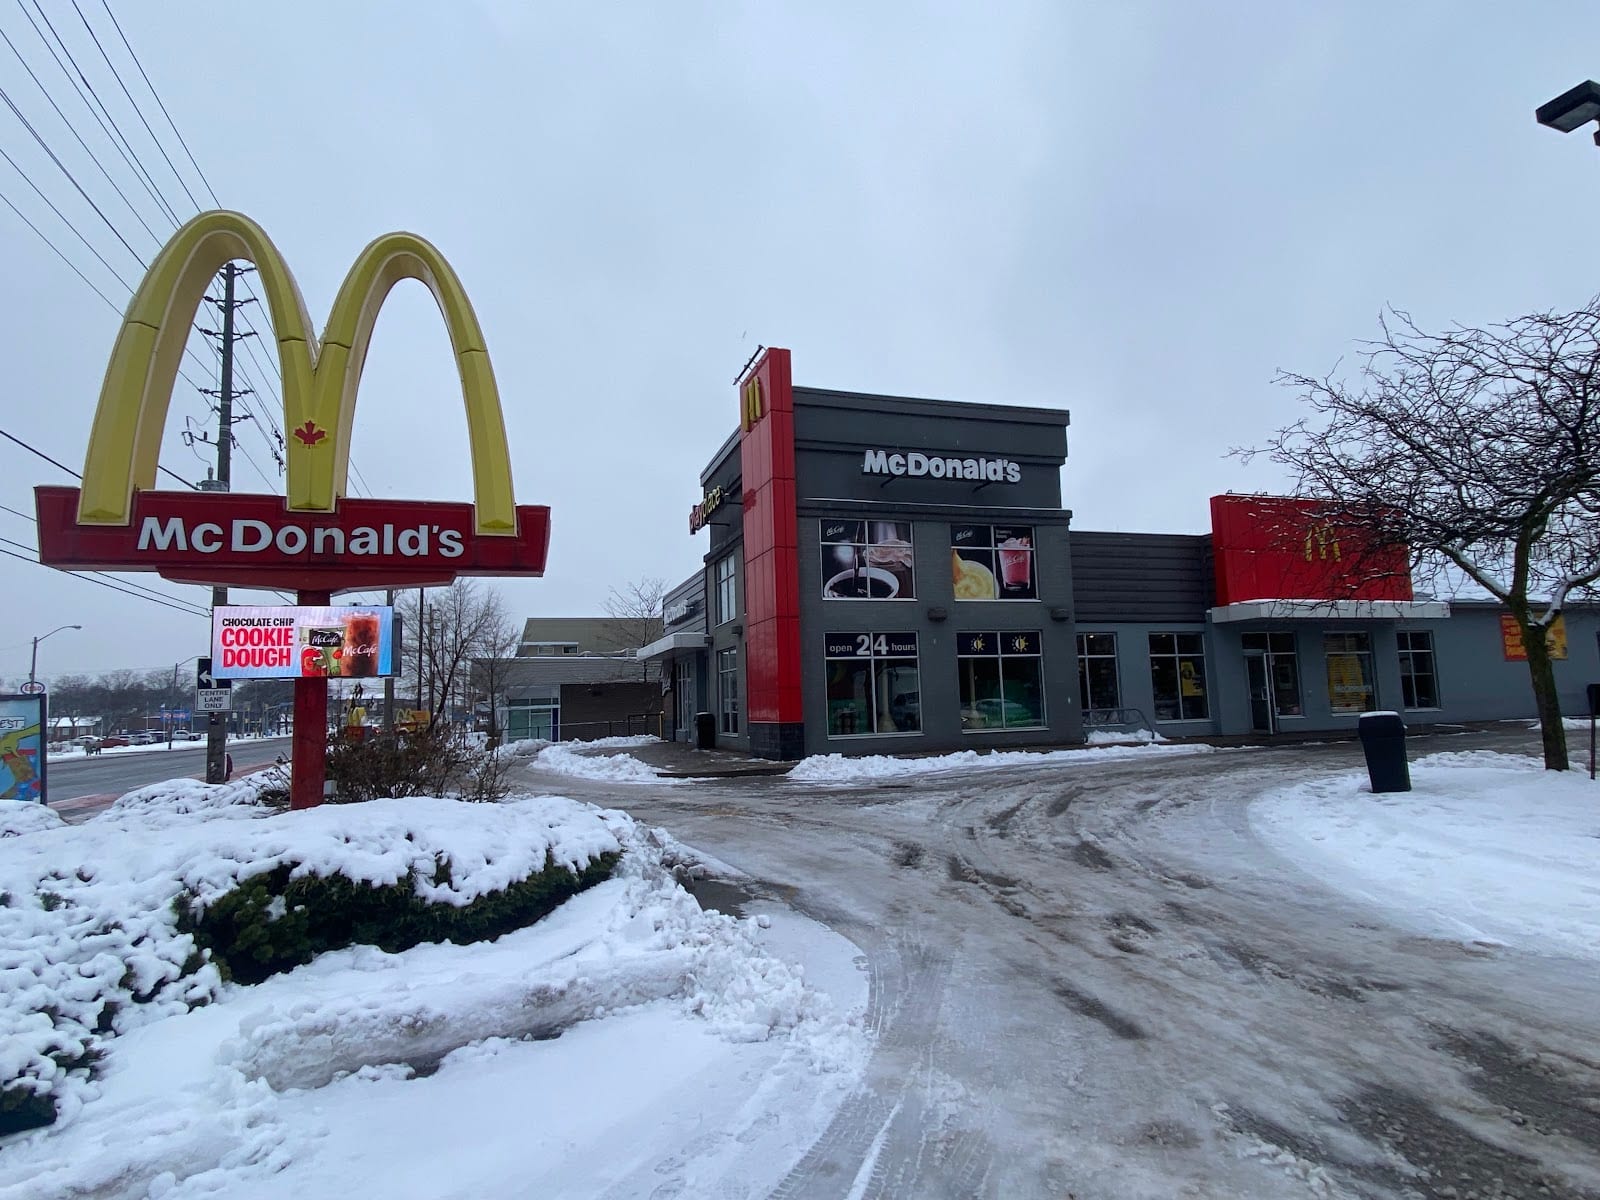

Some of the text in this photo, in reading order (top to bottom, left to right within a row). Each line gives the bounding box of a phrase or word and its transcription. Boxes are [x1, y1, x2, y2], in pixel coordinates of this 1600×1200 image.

[863, 450, 1022, 483] McDonald's
[137, 515, 465, 558] McDonald's
[222, 618, 295, 627] CHOCOLATE CHIP
[221, 628, 294, 647] COOKIE
[829, 634, 916, 655] open 24 hours
[223, 648, 291, 667] DOUGH
